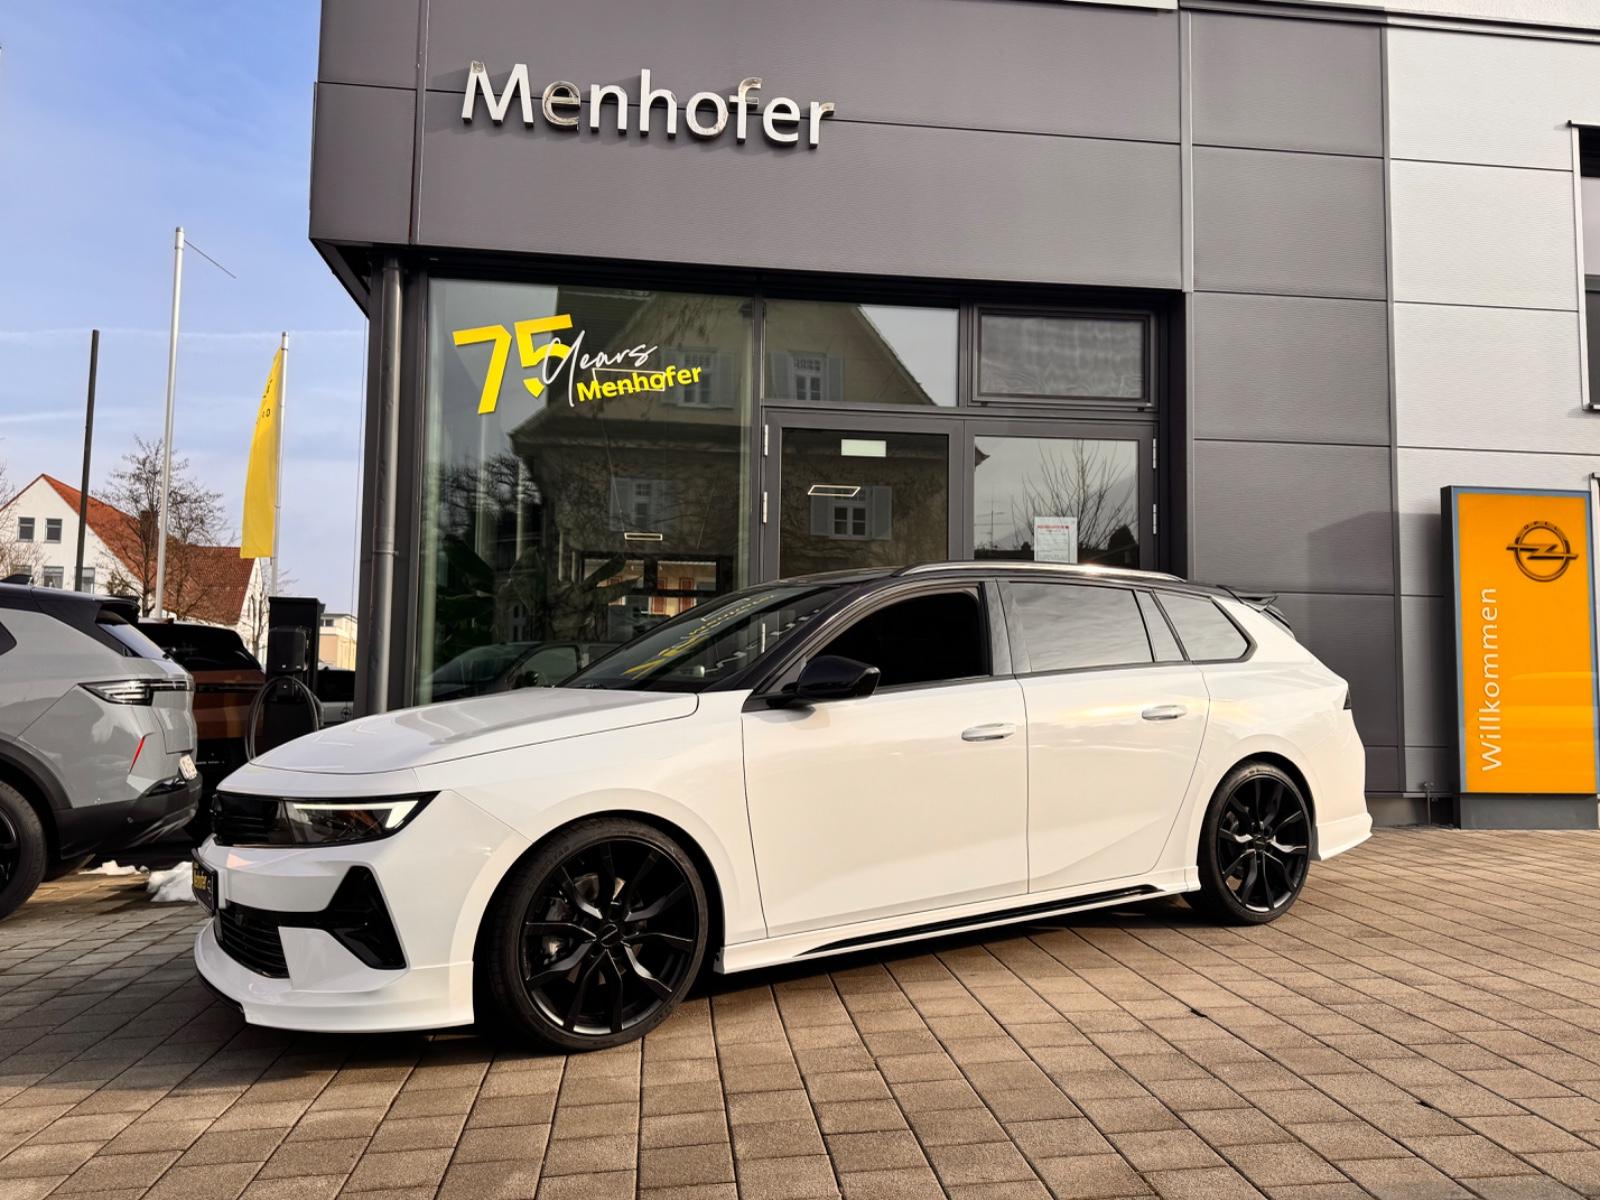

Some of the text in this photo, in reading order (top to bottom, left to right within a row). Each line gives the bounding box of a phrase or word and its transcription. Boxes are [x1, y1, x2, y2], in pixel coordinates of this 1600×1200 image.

[461, 61, 836, 149] Menhofer
[452, 313, 658, 415] 75 Years
[577, 364, 702, 402] Menhofer
[1478, 587, 1502, 772] Willkommen
